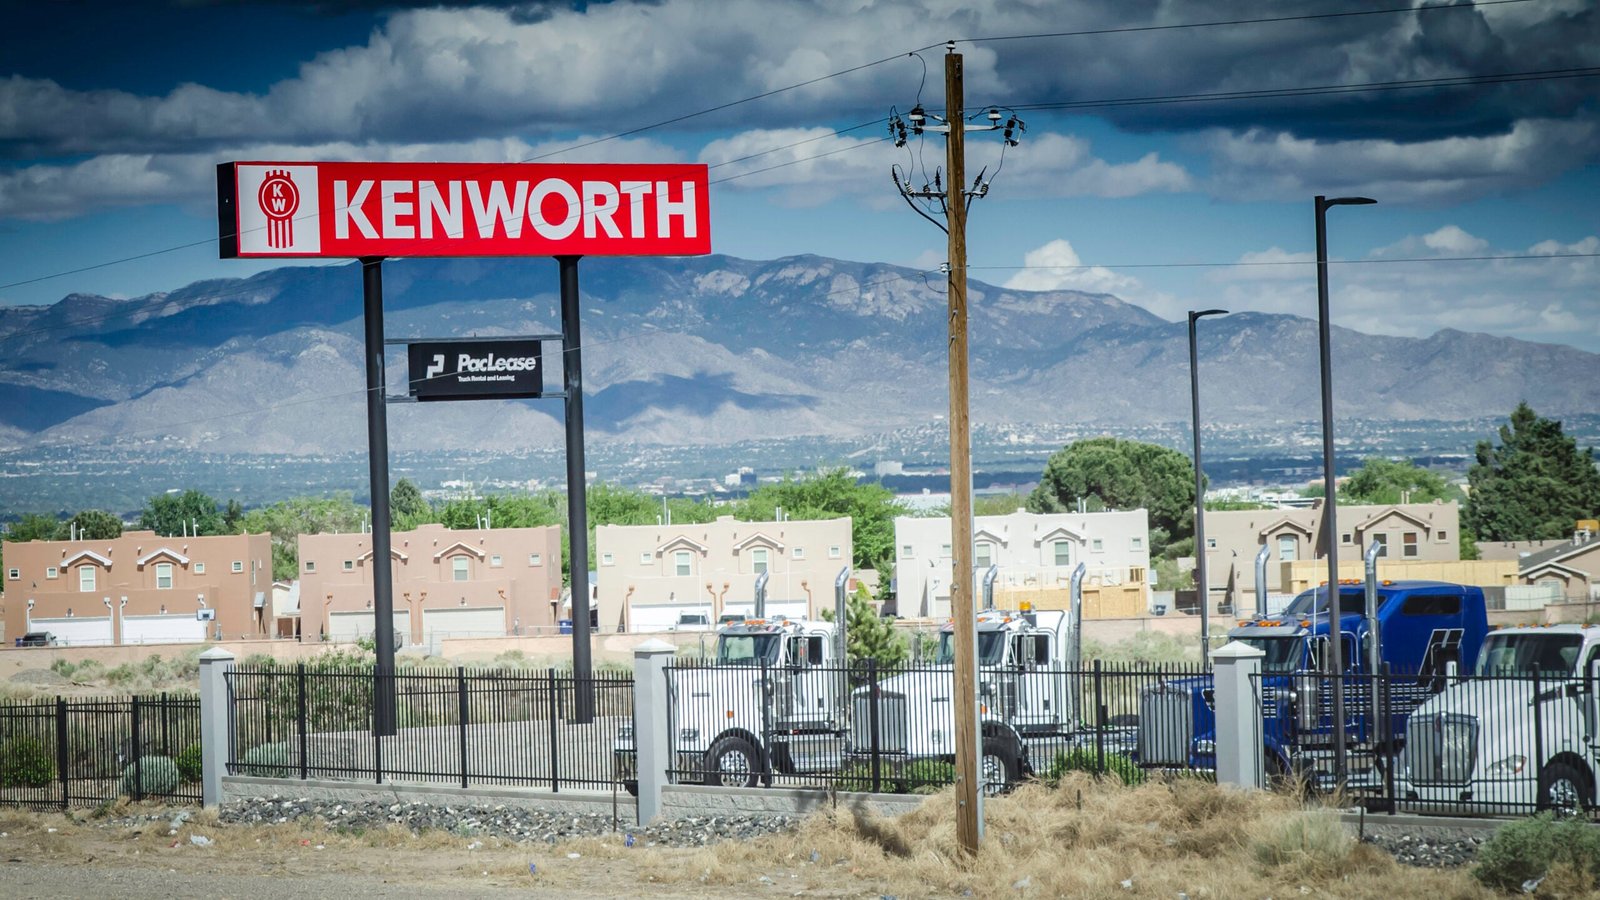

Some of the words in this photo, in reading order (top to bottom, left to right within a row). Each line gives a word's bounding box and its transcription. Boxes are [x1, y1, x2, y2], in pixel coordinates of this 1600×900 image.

[272, 183, 284, 198] K
[271, 198, 286, 212] W
[334, 178, 697, 240] KENWORTH
[457, 353, 536, 373] PacLease
[496, 374, 515, 382] Leasing
